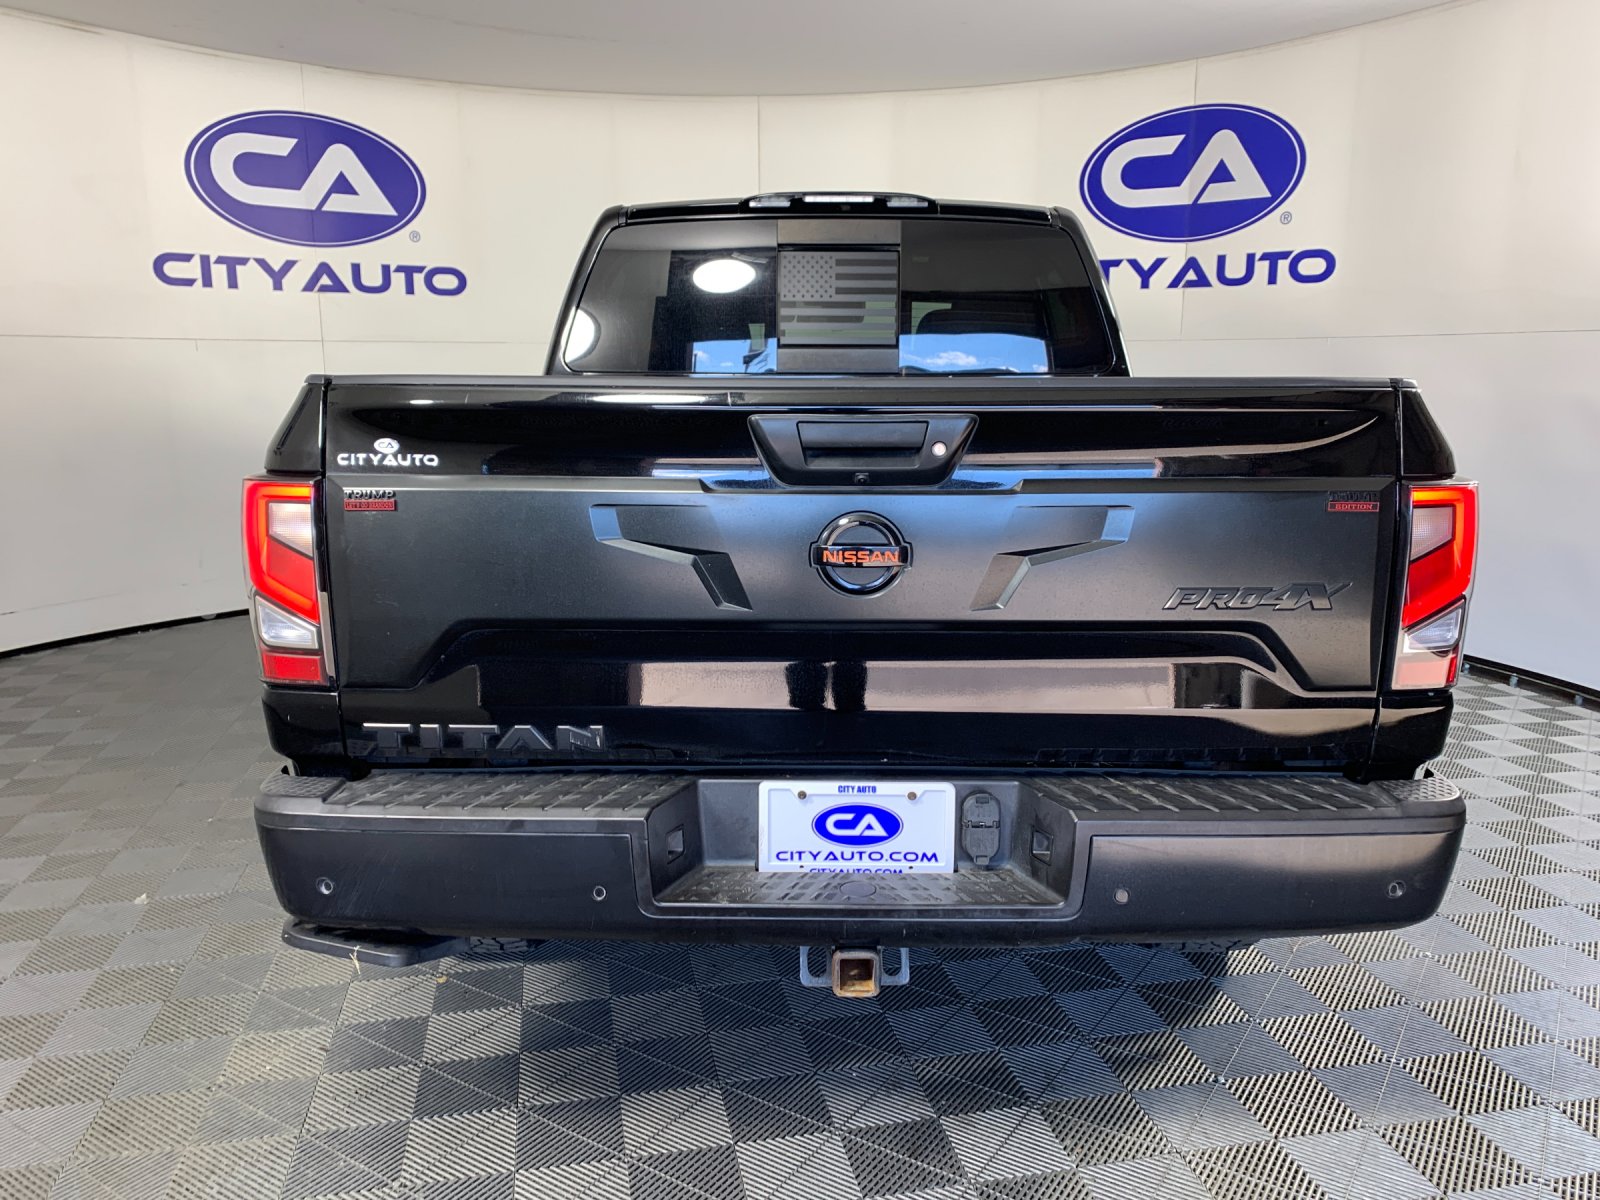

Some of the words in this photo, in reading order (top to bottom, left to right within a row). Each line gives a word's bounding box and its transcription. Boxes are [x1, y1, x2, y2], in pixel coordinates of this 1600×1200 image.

[210, 132, 398, 217] CA
[1101, 128, 1272, 208] CA
[336, 453, 439, 467] CITYAUTO
[344, 489, 395, 499] TRUMP
[822, 549, 899, 563] NISSAN
[362, 722, 604, 750] TITAN
[837, 785, 855, 794] CITY
[857, 785, 877, 794] AUTO
[825, 813, 889, 837] CA
[776, 850, 939, 863] CITYAUTO.COM
